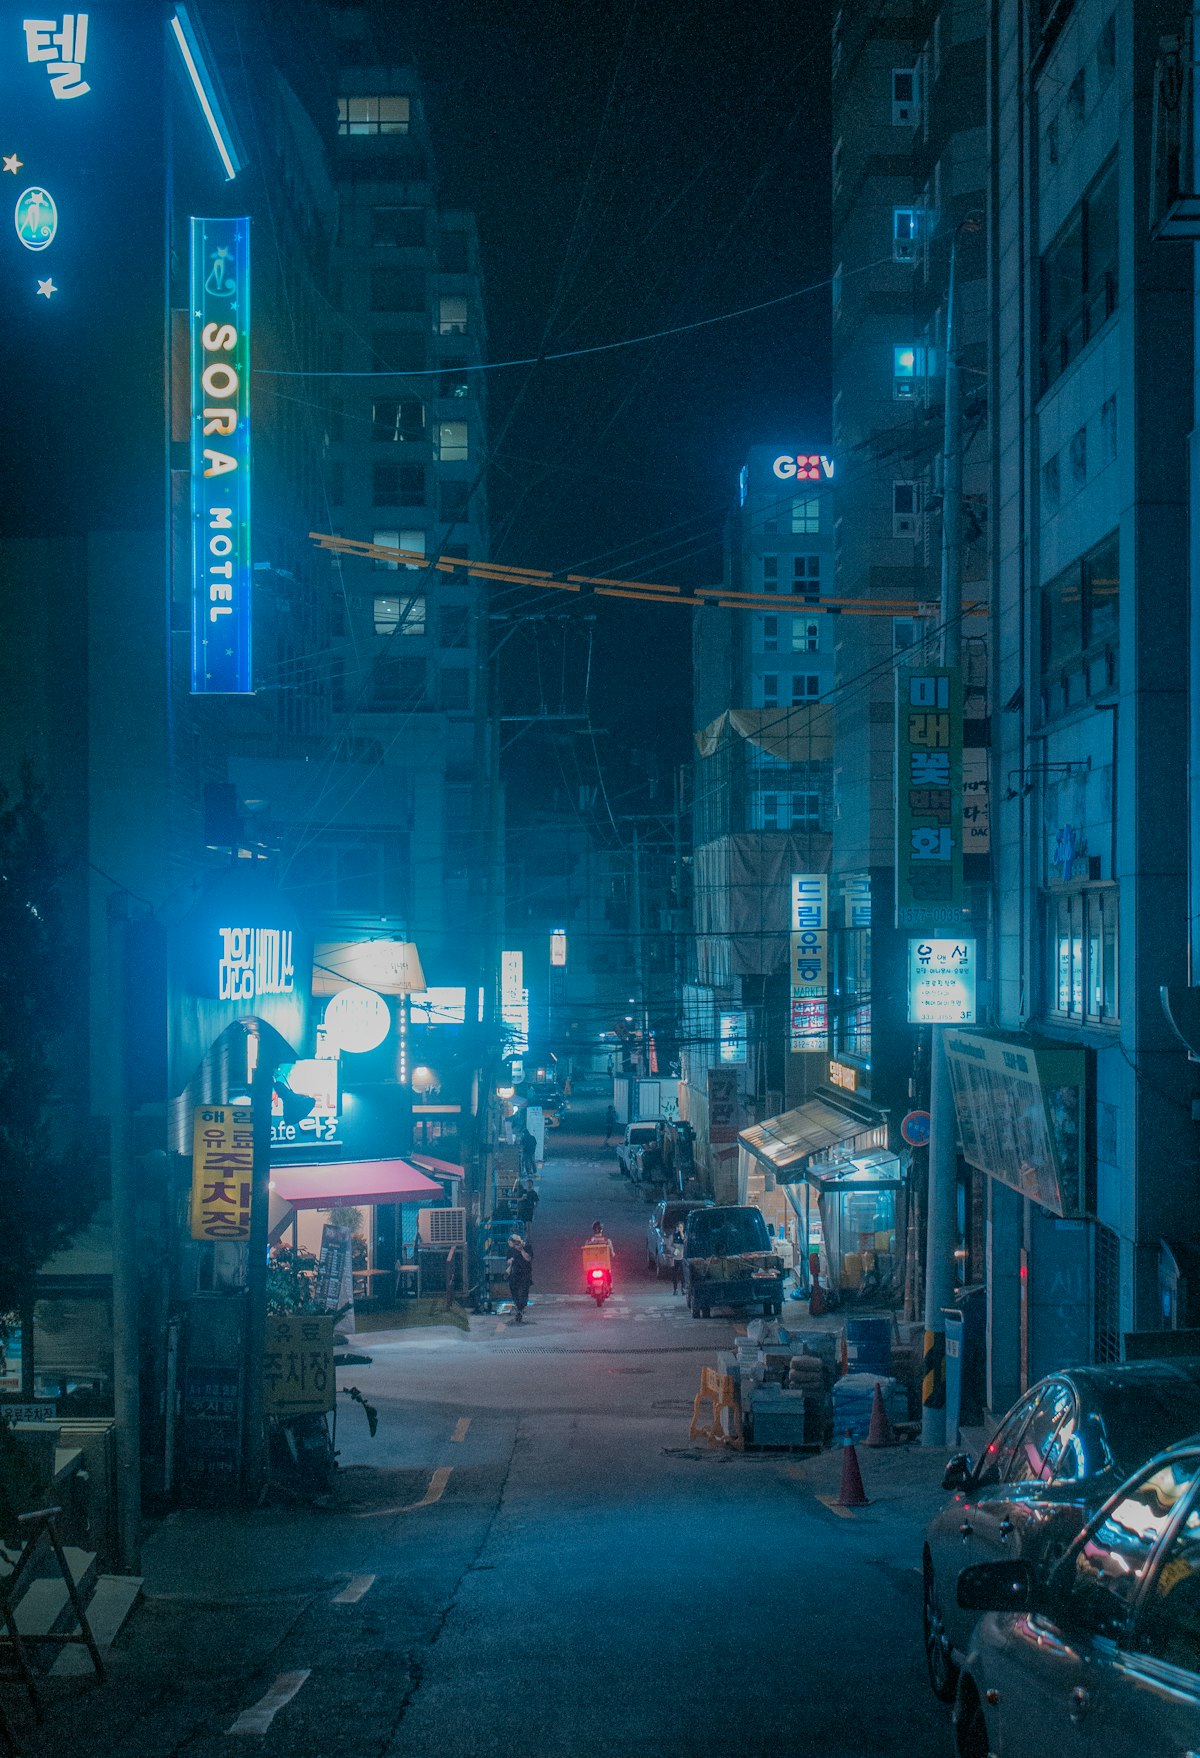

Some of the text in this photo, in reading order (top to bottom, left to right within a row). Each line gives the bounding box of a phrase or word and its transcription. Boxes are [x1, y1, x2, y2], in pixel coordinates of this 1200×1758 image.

[23, 14, 90, 100] 텔
[202, 322, 238, 622] SORA MOTEL
[909, 675, 955, 902] 미래꽃백화점
[797, 880, 823, 982] 드림유통
[901, 907, 961, 924] 1577-0035
[917, 944, 932, 965] 유
[951, 945, 968, 965] 설
[794, 985, 826, 997] MARKET
[960, 1011, 972, 1019] 3F
[203, 1129, 254, 1149] 유료
[201, 1152, 253, 1238] 주차장
[274, 1323, 320, 1343] 유료
[263, 1350, 331, 1392] 주차장
